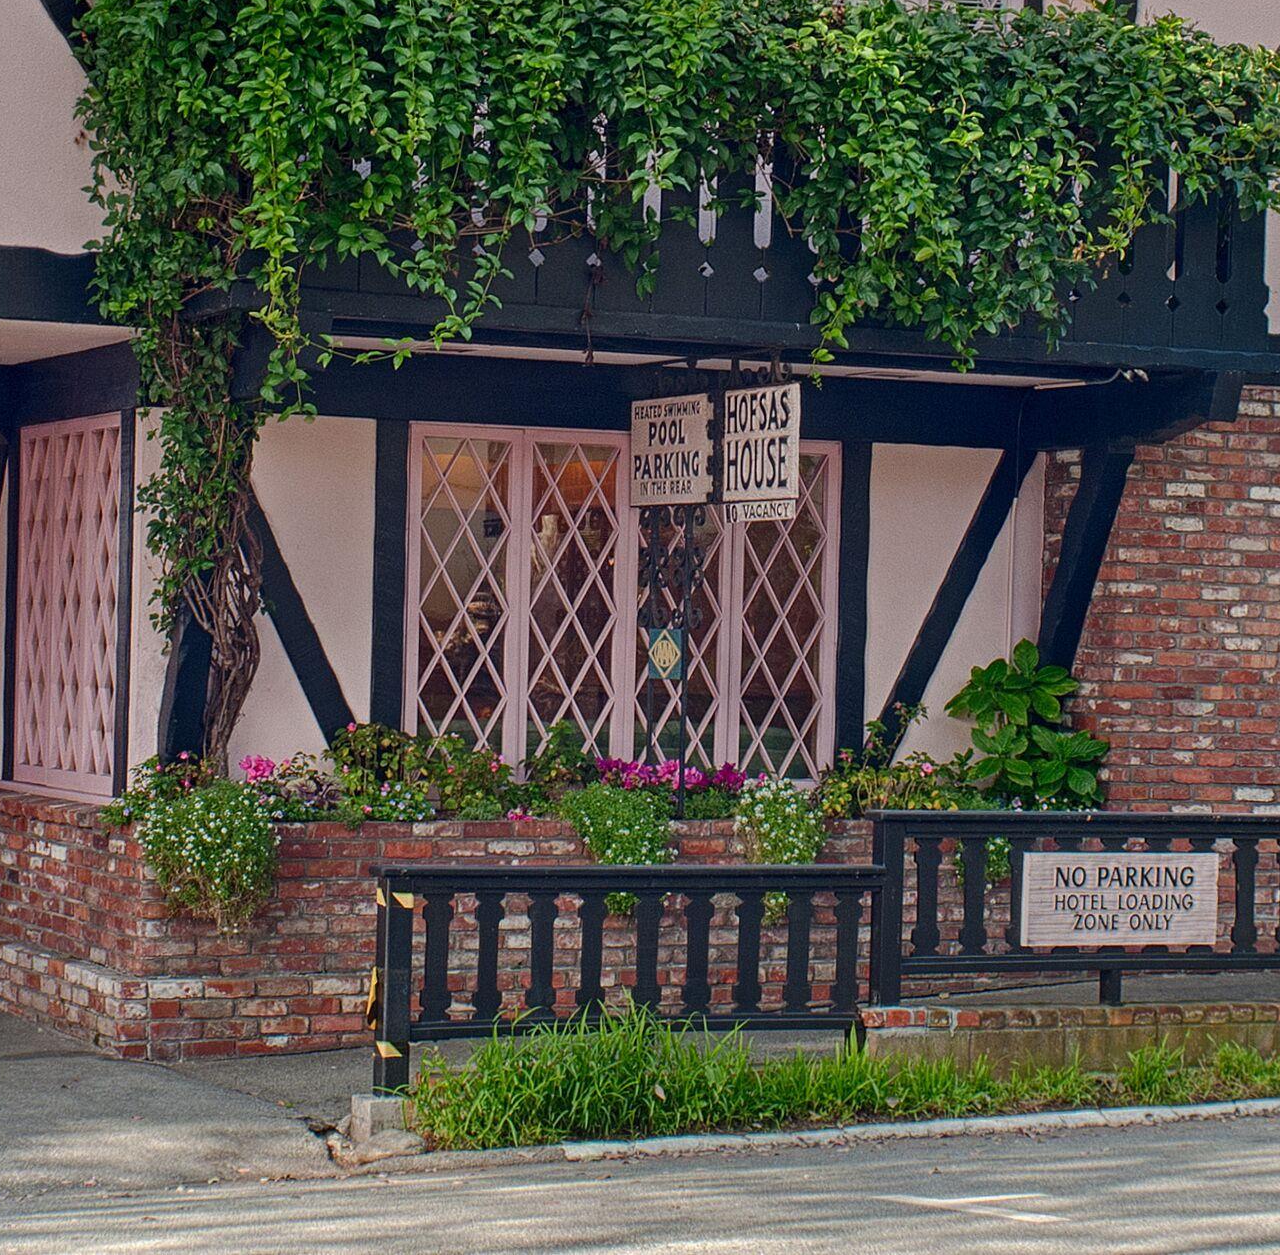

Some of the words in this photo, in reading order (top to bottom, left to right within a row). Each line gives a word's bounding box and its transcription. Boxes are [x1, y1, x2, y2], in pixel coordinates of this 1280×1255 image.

[634, 404, 661, 420] HEATED
[663, 401, 701, 418] SWIMMING
[726, 389, 791, 434] HOFSAS
[648, 419, 686, 447] POOL
[633, 451, 700, 480] PARKING
[726, 436, 788, 491] HOUSE
[640, 481, 649, 496] IN
[651, 481, 667, 495] THE
[669, 480, 693, 494] REAR
[743, 503, 790, 519] VACANCY
[1055, 866, 1087, 888] NO
[1097, 866, 1195, 888] PARKING
[1055, 894, 1107, 910] HOTEL
[1118, 894, 1194, 911] LOADING
[1073, 914, 1119, 930] ZONE
[1129, 914, 1174, 930] ONLY
